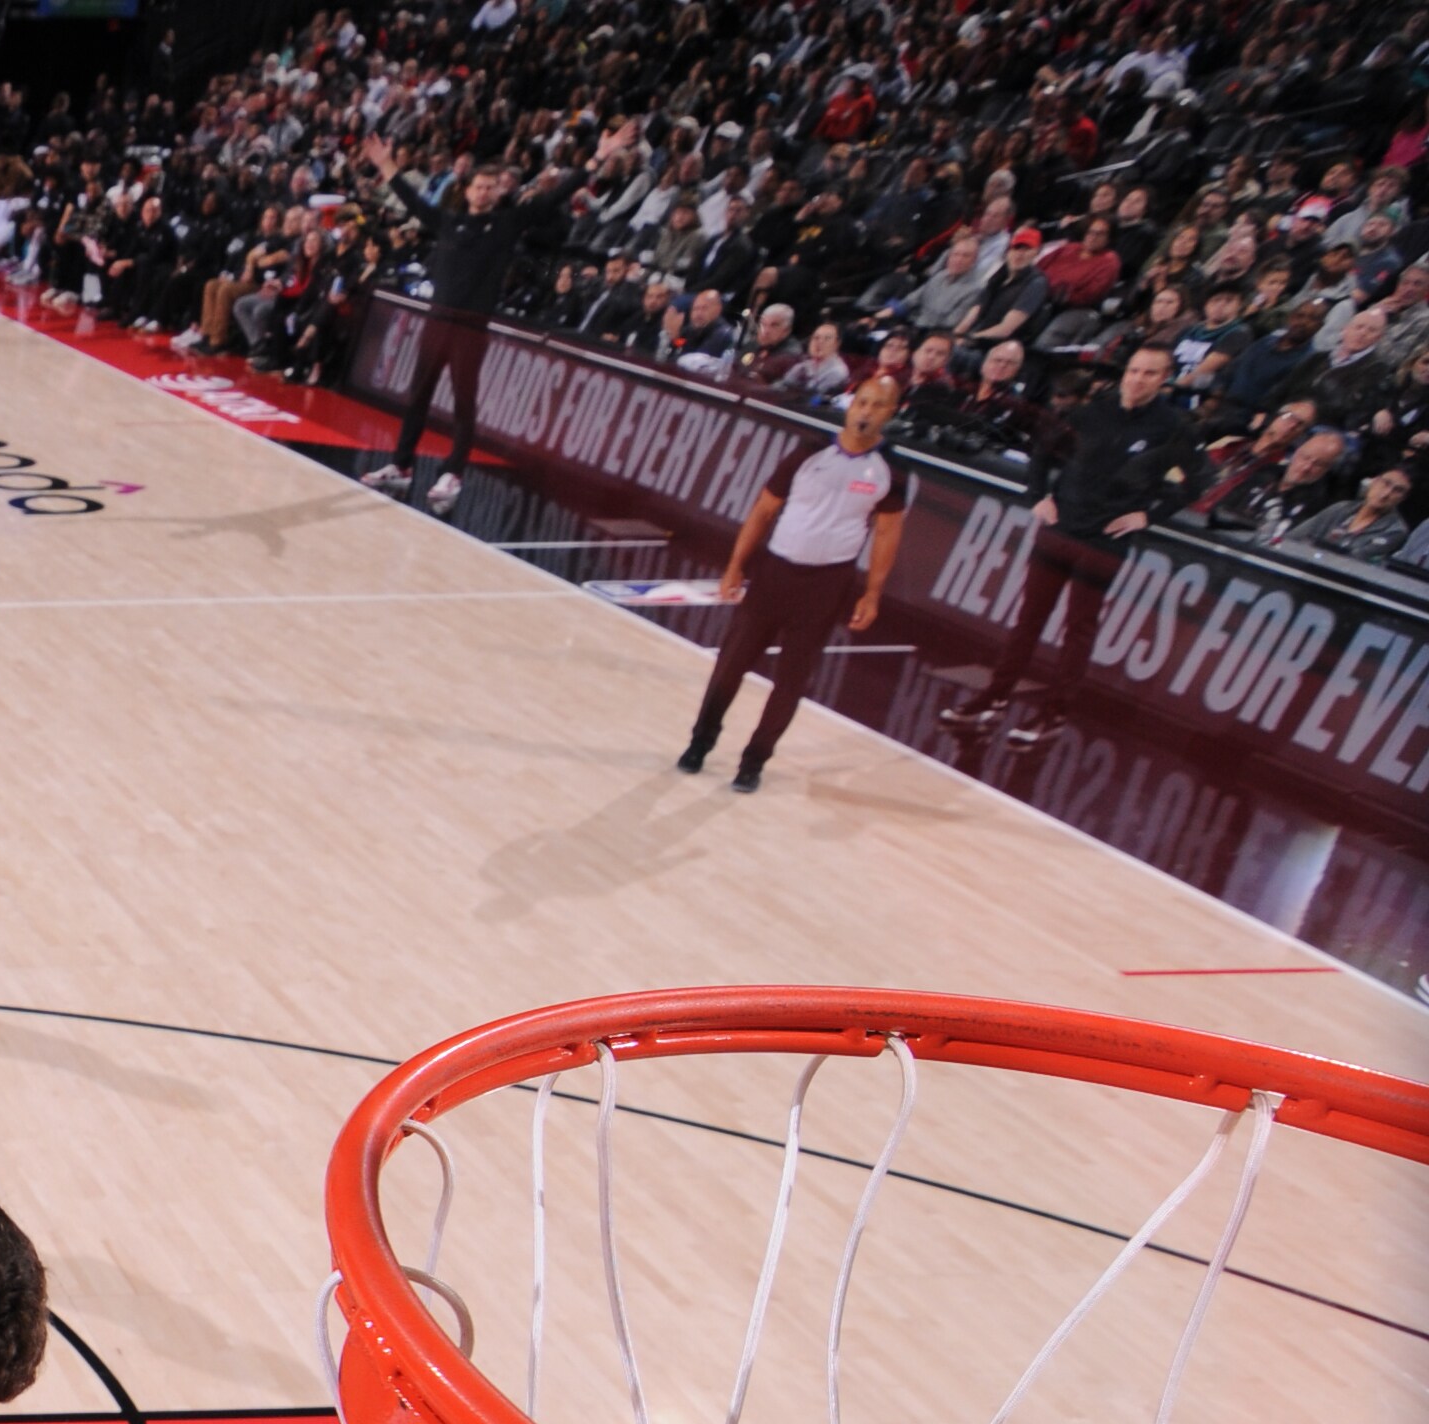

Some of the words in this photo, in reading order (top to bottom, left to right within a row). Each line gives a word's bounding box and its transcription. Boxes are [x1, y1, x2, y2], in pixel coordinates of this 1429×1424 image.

[546, 366, 625, 468] FOR
[603, 385, 731, 501] EVERY
[701, 417, 800, 523] FAN
[1169, 577, 1336, 732] FOR
